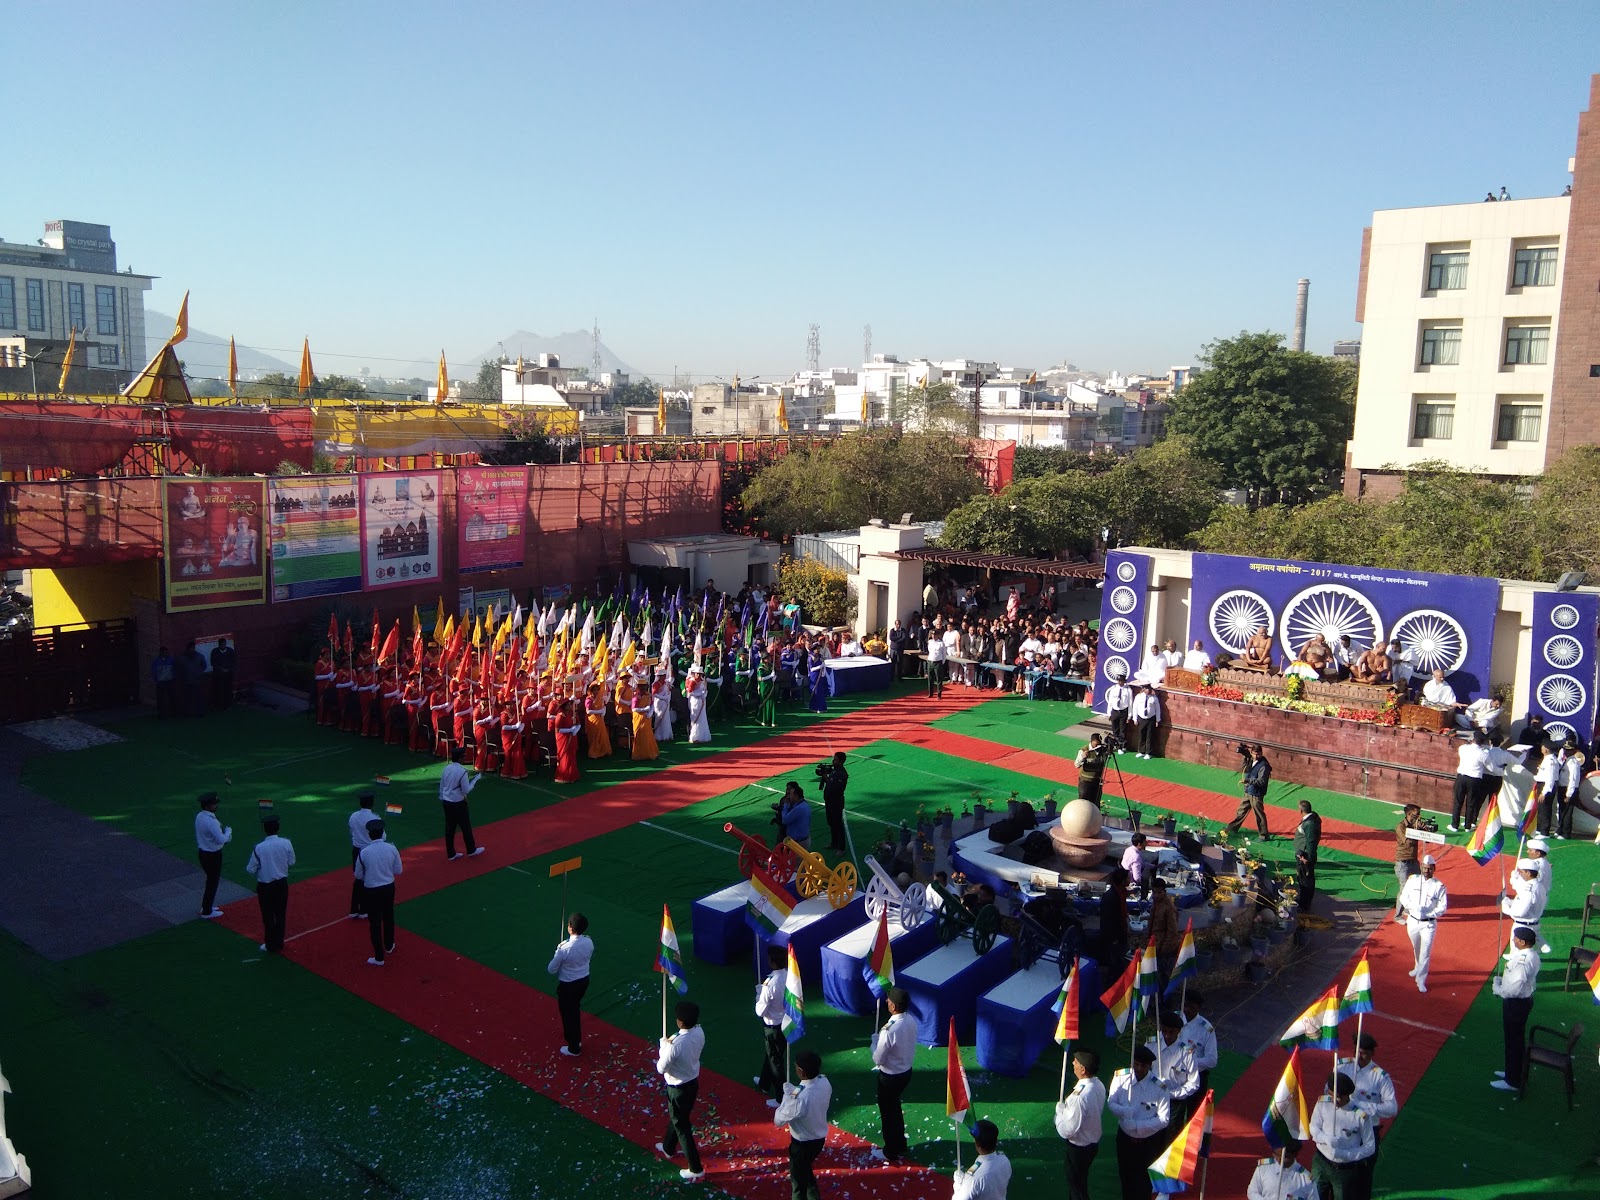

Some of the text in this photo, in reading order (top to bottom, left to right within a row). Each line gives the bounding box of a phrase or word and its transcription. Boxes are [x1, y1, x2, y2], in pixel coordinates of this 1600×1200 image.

[78, 239, 98, 248] crystal
[98, 241, 112, 249] park
[1249, 563, 1275, 572] अमृतमय
[1276, 564, 1302, 574] वर्षायोग
[1310, 568, 1332, 577] 2017
